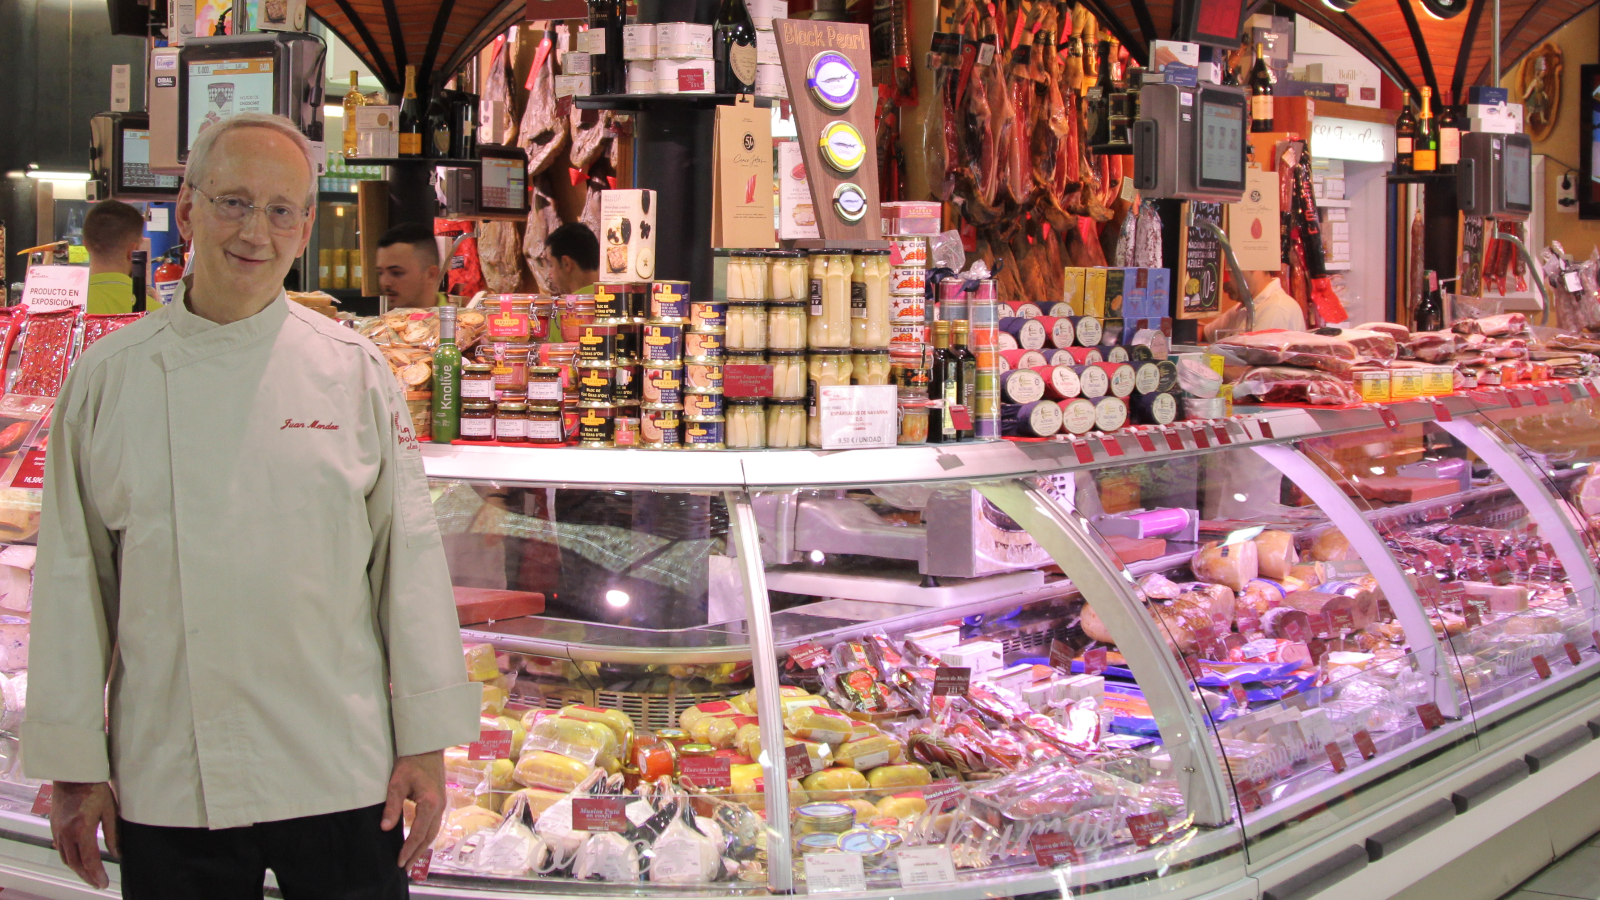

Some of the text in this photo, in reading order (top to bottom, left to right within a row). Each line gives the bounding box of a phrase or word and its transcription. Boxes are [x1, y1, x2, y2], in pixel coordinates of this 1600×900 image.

[784, 22, 866, 50] Black Pearl
[30, 288, 67, 296] PRODUCTO
[31, 297, 74, 307] EXPOSICIÓN
[440, 364, 452, 410] Knolive
[26, 404, 45, 413] 3x2
[280, 418, 305, 430] Juan
